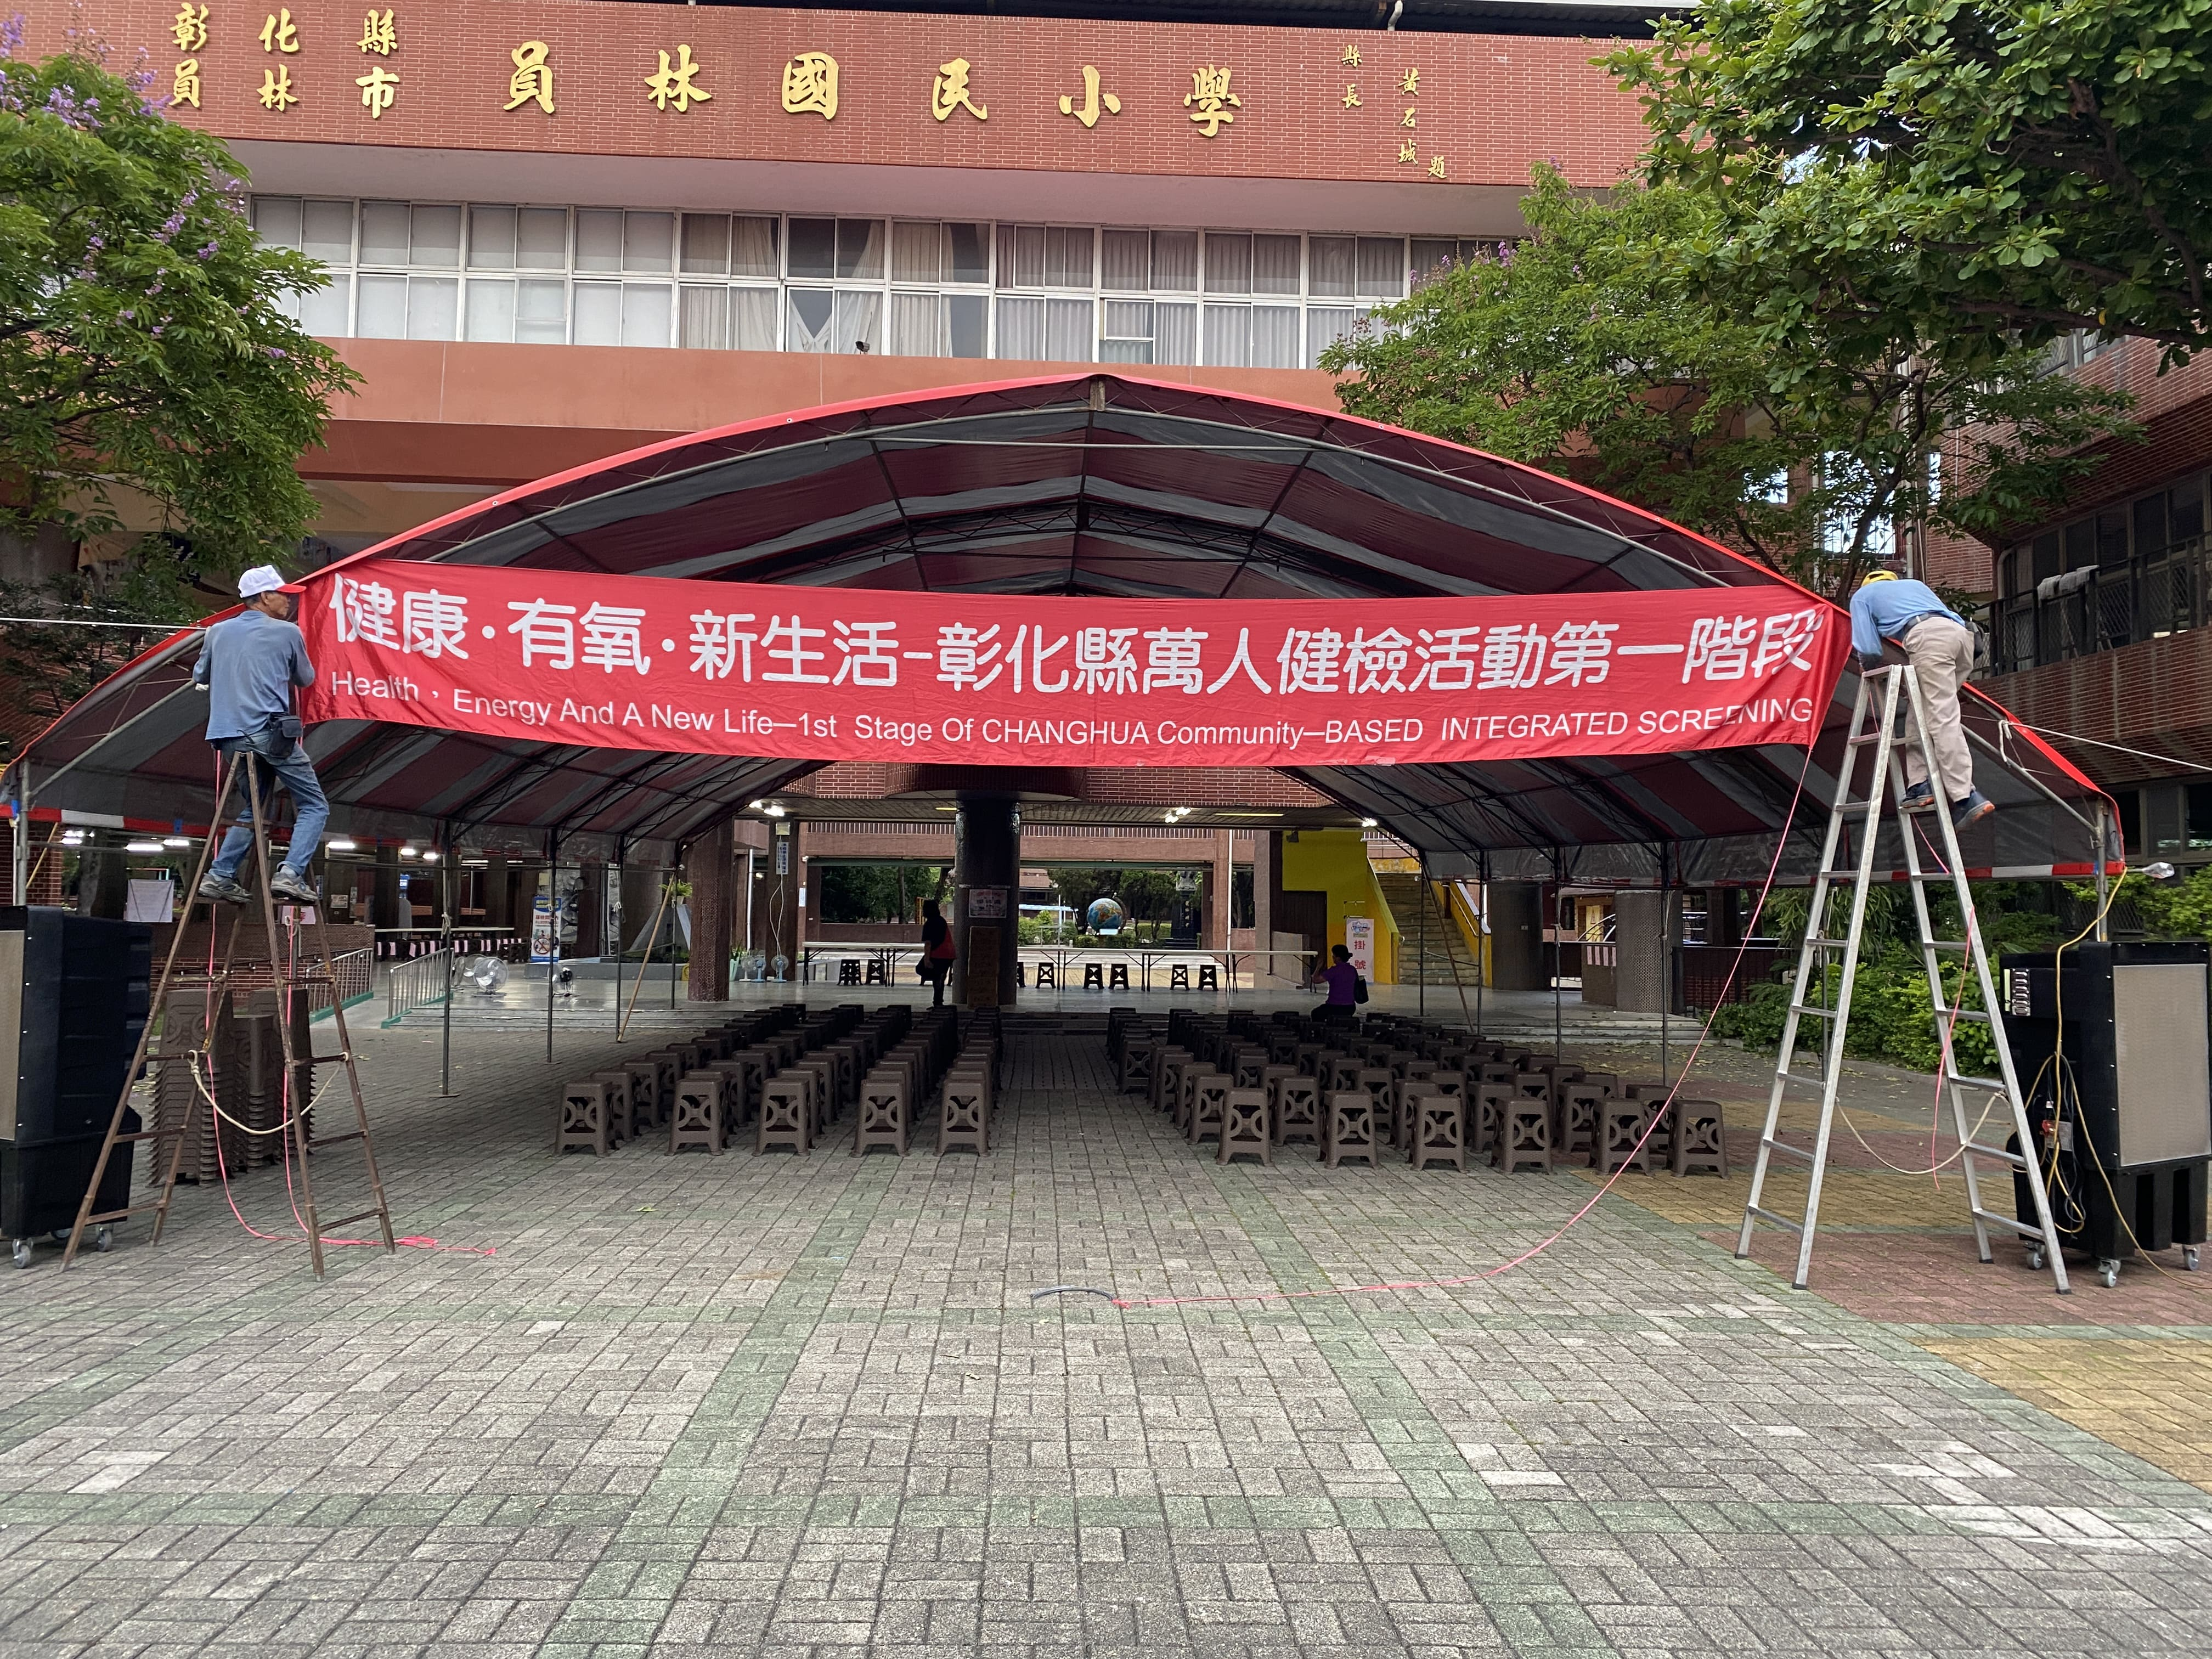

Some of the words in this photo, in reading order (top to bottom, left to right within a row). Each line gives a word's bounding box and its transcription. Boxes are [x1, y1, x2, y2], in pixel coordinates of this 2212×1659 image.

[169, 2, 398, 56] 彰化縣
[168, 58, 400, 119] 員林市
[503, 40, 1242, 137] 員林國民小學
[1341, 44, 1363, 109] 縣長
[453, 688, 552, 726] Energy
[559, 697, 614, 725] And
[622, 702, 645, 728] A
[651, 703, 715, 731] New
[854, 714, 933, 747] Stage
[942, 717, 974, 742] Of
[982, 719, 1150, 745] CHANGHUA
[1441, 712, 1628, 741] INTEGRATED
[1637, 698, 1813, 735] SCREENING
[1354, 940, 1366, 970] 掛號
